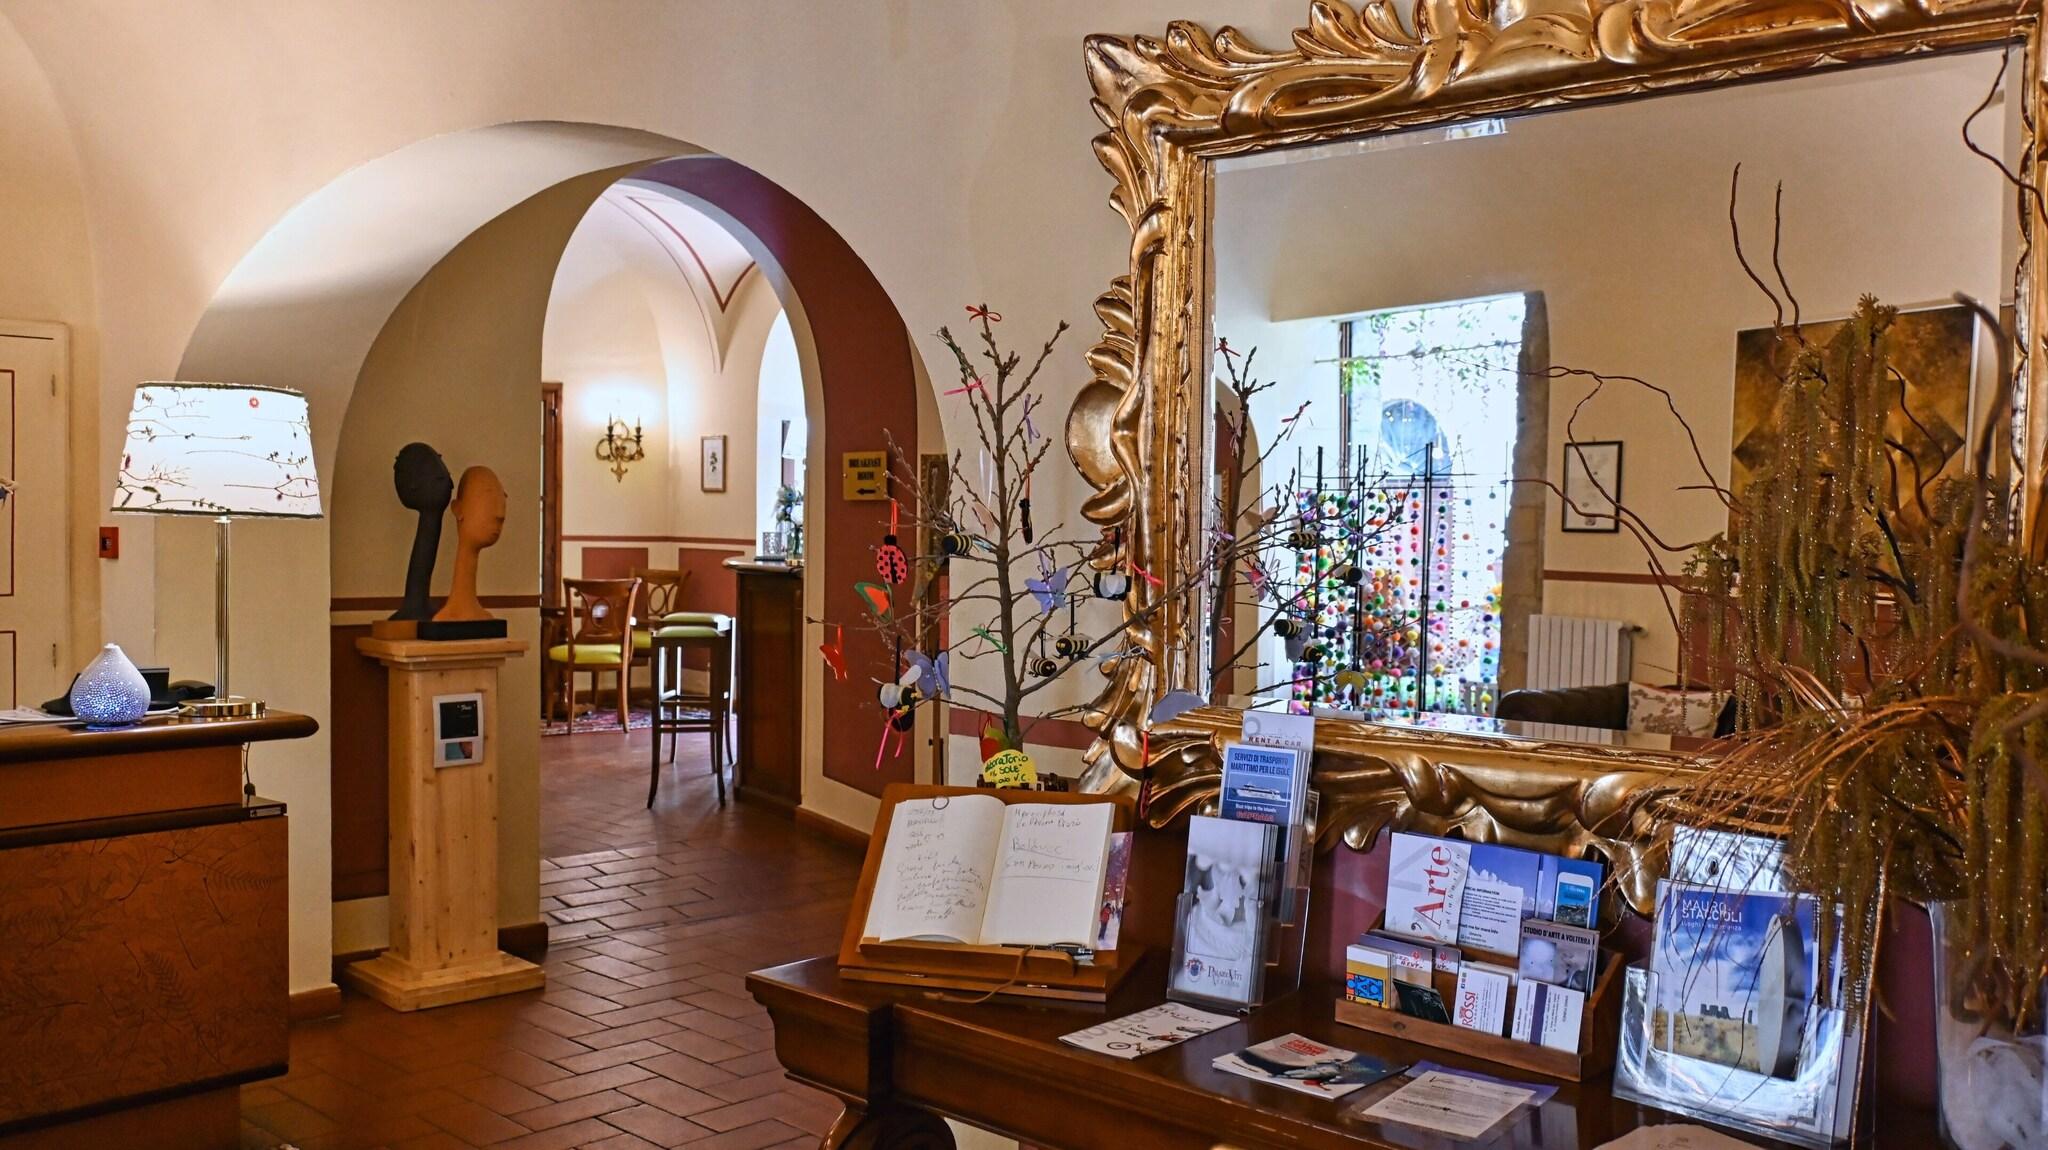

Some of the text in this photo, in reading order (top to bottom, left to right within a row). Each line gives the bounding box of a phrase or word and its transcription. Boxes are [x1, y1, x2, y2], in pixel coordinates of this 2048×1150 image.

[848, 458, 881, 468] BREAKFAST
[857, 471, 874, 481] ROOM
[1248, 736, 1271, 744] RENT
[1284, 740, 1302, 748] CAR
[1234, 753, 1289, 767] SERVIZI DI TRASPORTO
[1230, 762, 1290, 776] MARITTIMO PER LE ISOLE
[1682, 900, 1727, 912] MAURO
[1523, 927, 1543, 936] STUDIO
[1543, 930, 1560, 939] D'ARTE
[1566, 934, 1590, 945] VOLTERRA
[1462, 991, 1476, 1027] ROSSI
